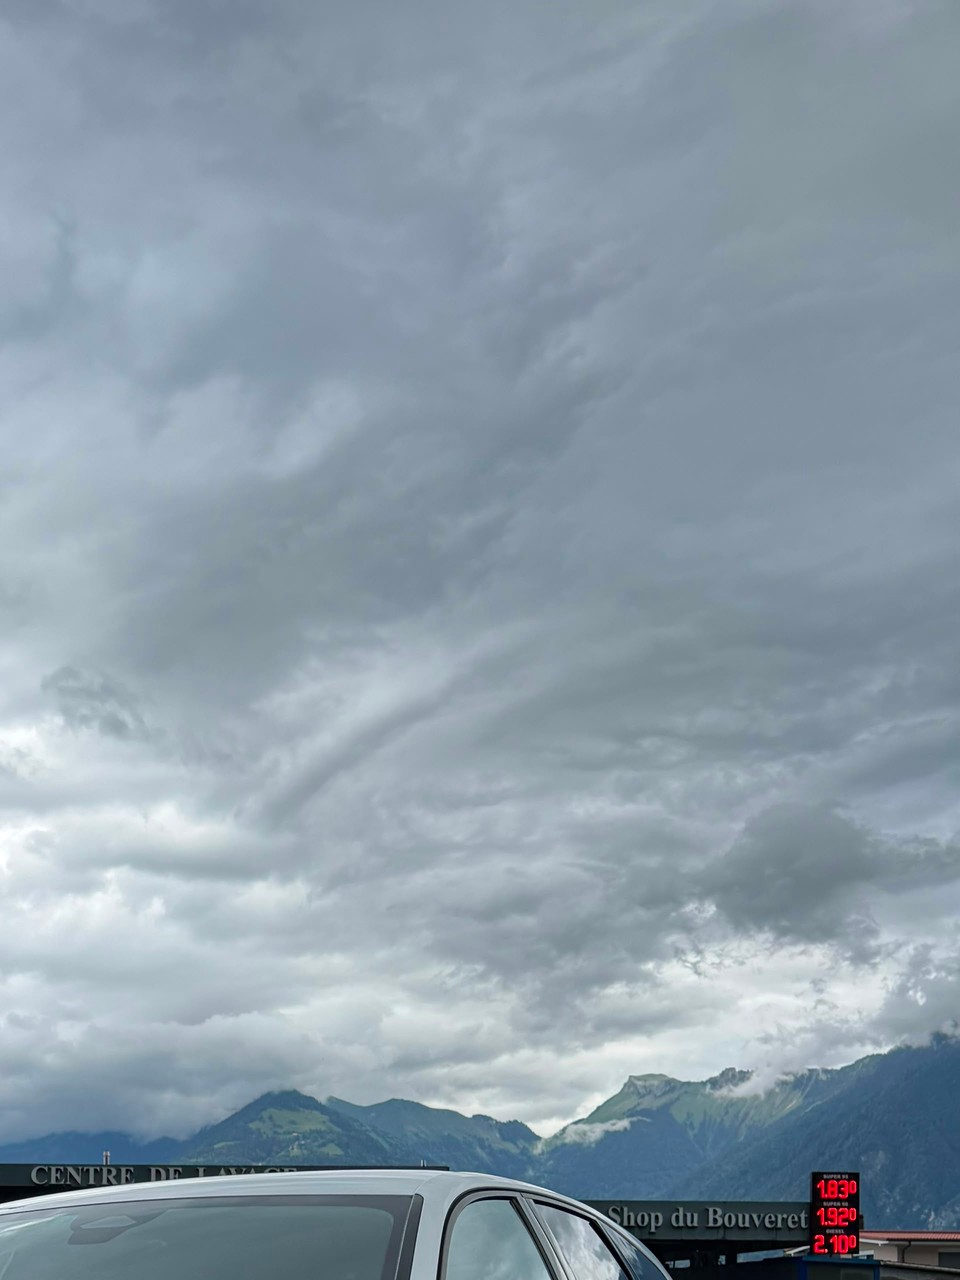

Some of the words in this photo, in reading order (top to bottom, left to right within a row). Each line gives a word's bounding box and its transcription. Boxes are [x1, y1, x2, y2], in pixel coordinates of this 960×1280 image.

[30, 1165, 136, 1186] CENTRE
[608, 1206, 664, 1233] Shop
[670, 1207, 699, 1228] du
[705, 1207, 809, 1229] Bouveret
